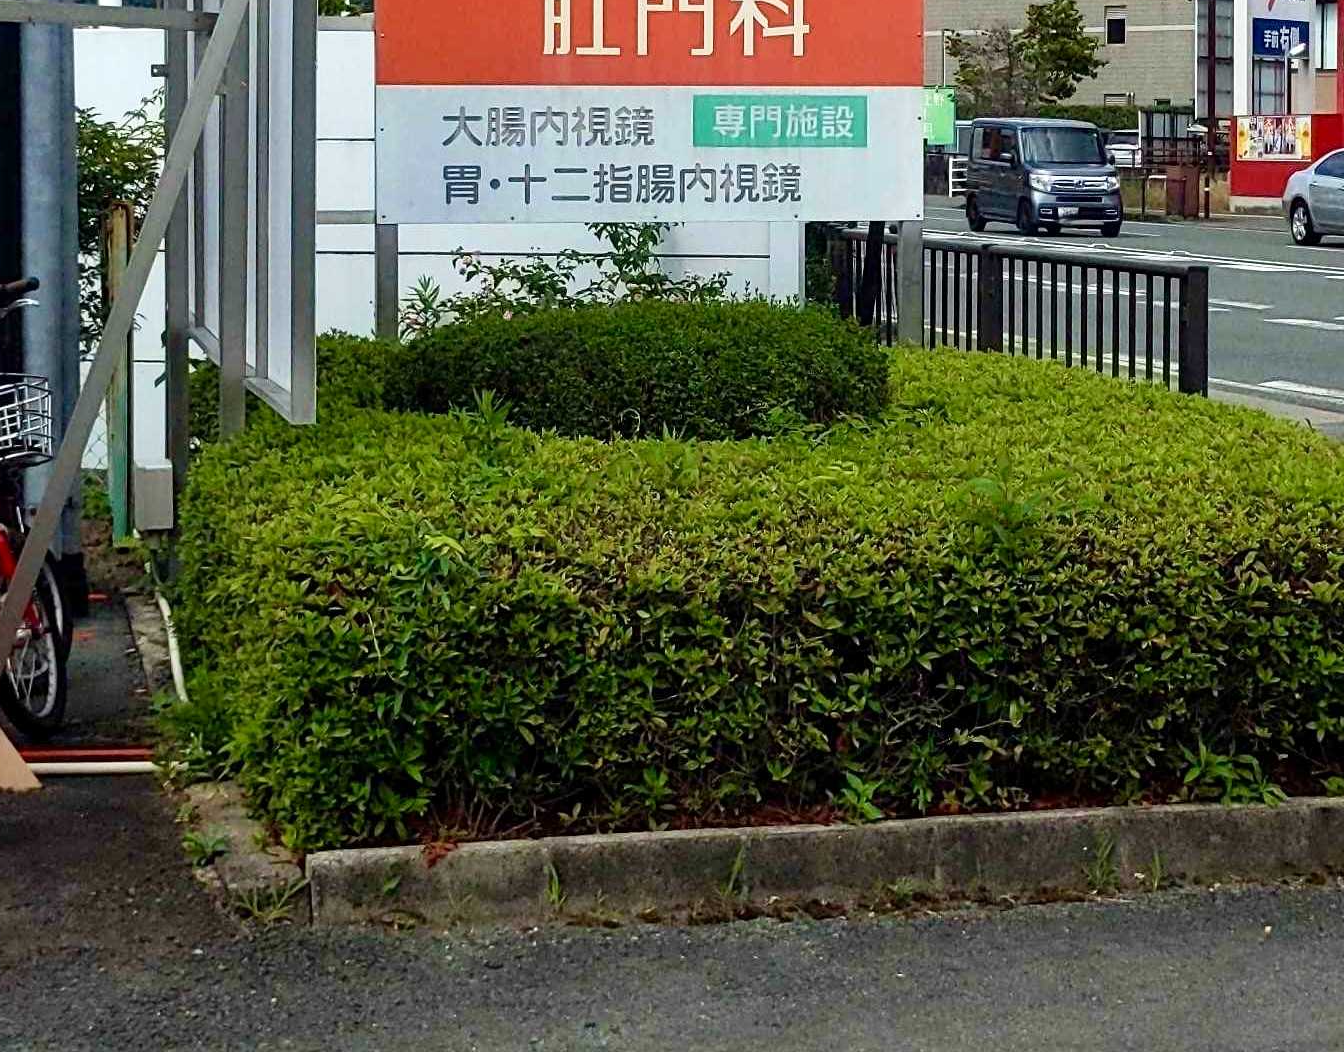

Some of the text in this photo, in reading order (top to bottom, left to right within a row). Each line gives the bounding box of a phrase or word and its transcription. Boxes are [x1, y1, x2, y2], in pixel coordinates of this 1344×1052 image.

[442, 103, 855, 148] 大腸内視鏡 専門施設
[443, 162, 801, 206] 胃・十二指腸内視鏡
